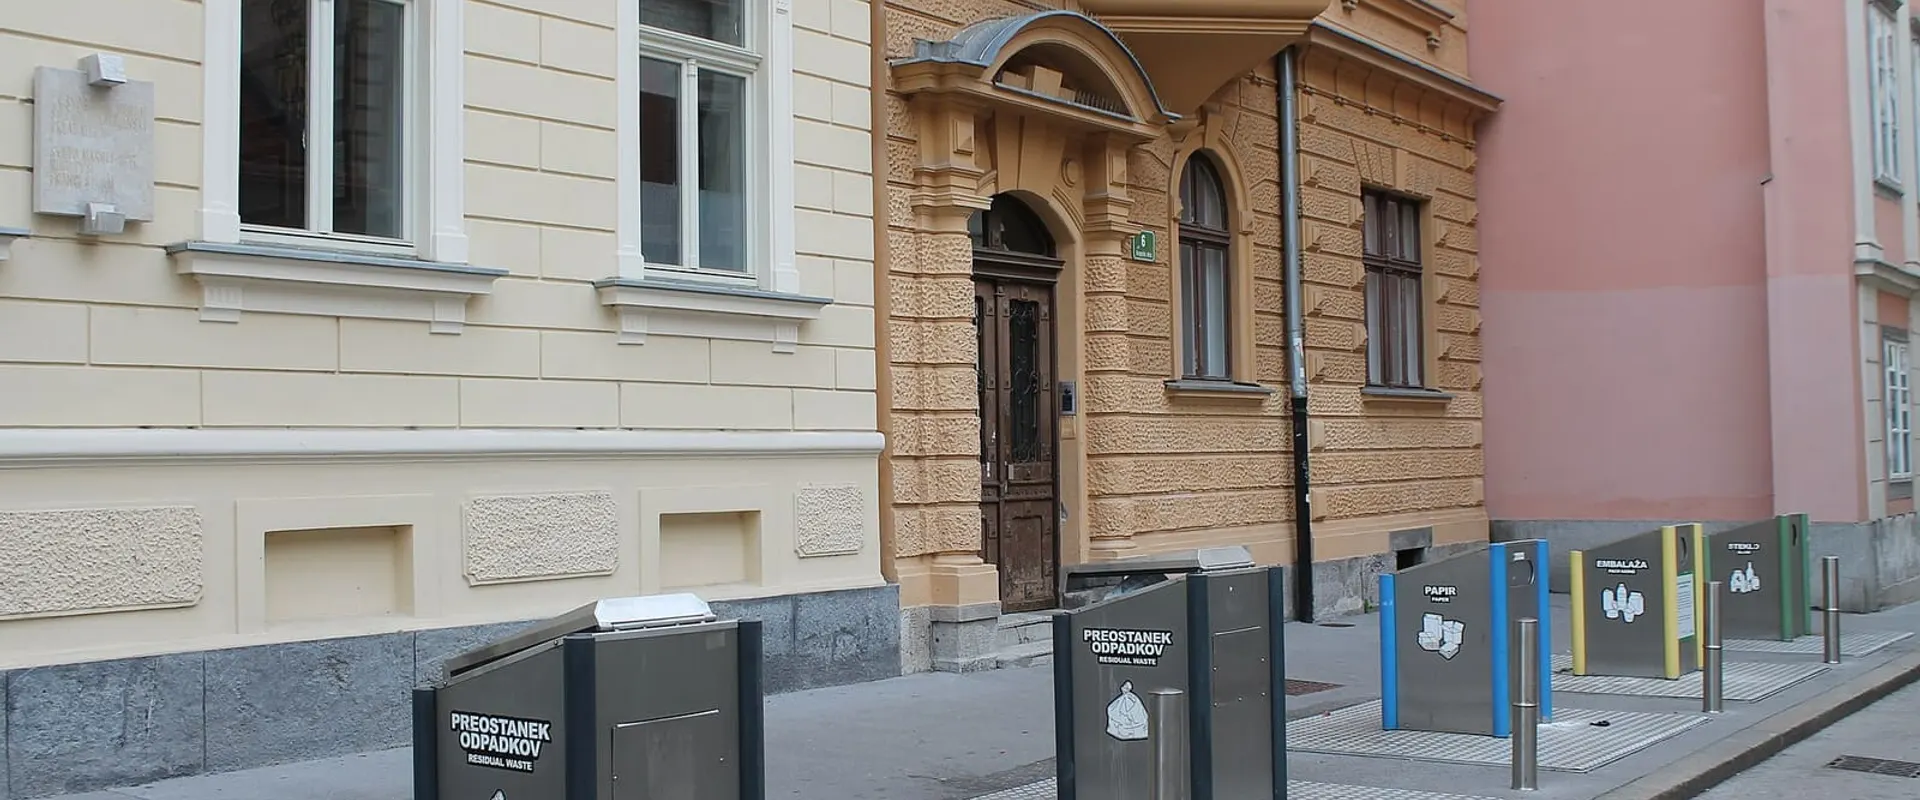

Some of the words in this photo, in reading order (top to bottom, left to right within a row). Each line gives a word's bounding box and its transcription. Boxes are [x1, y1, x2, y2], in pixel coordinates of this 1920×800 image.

[1424, 586, 1456, 595] PAPIR
[1083, 629, 1172, 644] PREOSTANEK
[1092, 641, 1164, 655] ODPADKOV
[1099, 656, 1132, 664] RESIDUAL
[1132, 657, 1157, 665] WASTE
[451, 713, 550, 740] PREOSTANEK
[460, 731, 541, 757] ODPADKOV
[468, 753, 504, 767] RESIDUAL
[505, 758, 533, 771] WASTE
